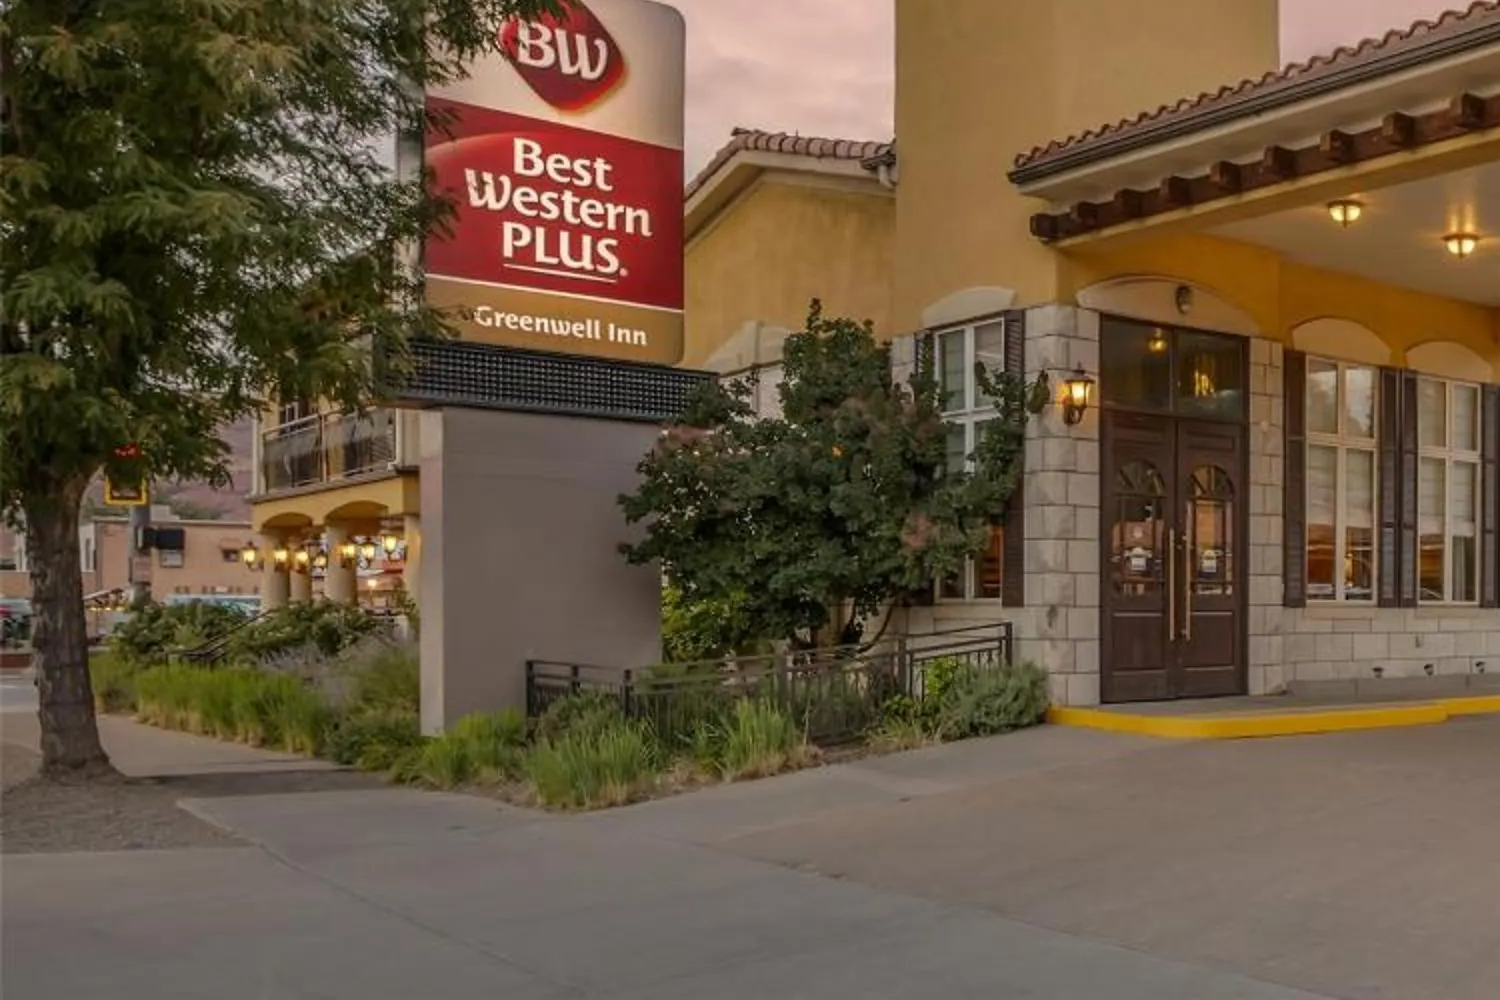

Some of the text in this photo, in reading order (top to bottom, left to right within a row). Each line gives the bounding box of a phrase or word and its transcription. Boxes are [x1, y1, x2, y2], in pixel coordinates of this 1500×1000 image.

[517, 19, 608, 80] BW
[513, 137, 613, 191] Best
[464, 167, 653, 237] Western
[474, 305, 648, 346] Greenwell Inn
